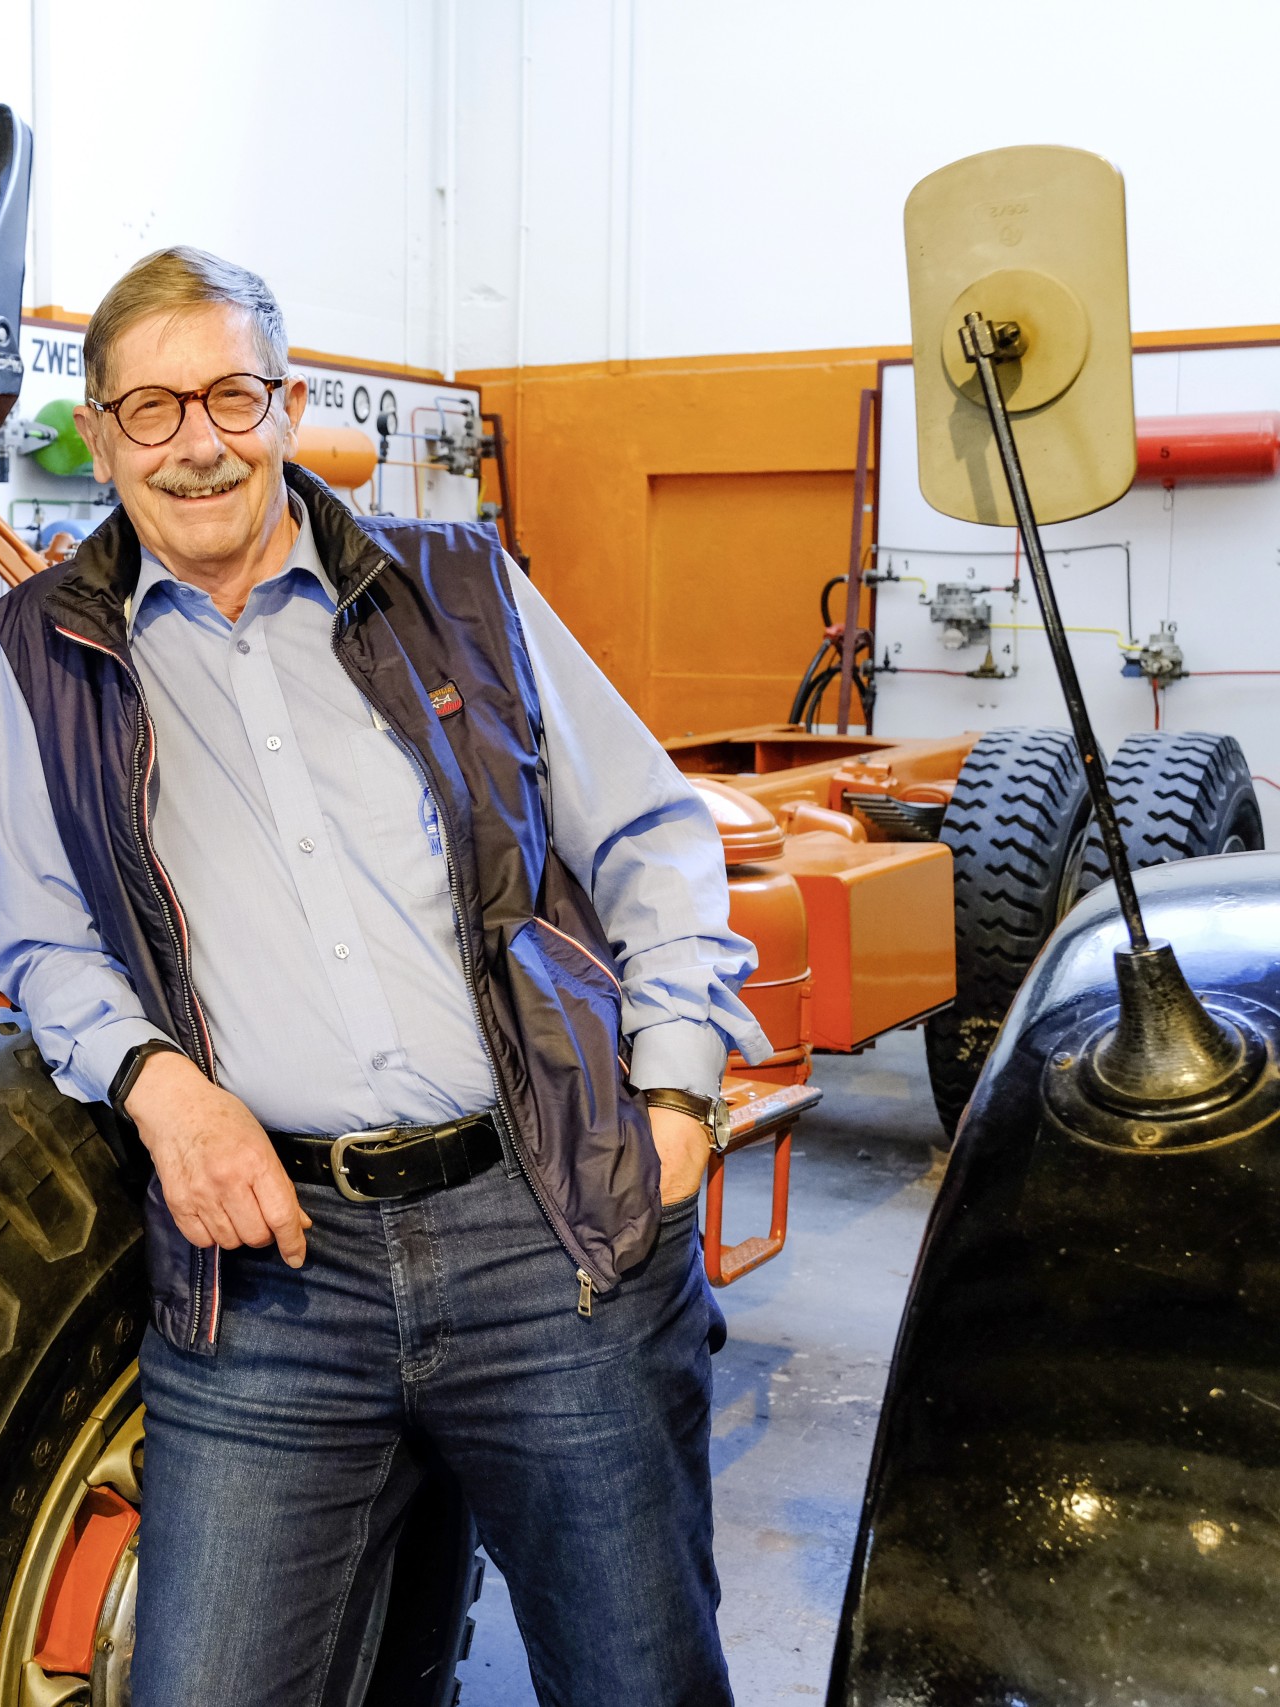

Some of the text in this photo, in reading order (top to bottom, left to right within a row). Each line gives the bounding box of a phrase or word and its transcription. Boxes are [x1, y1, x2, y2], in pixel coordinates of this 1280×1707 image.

[32, 339, 82, 377] ZWEI
[308, 377, 344, 408] H/EG
[1160, 446, 1170, 459] 5
[967, 566, 975, 579] 3
[893, 642, 902, 654] 2
[1002, 643, 1010, 654] 4
